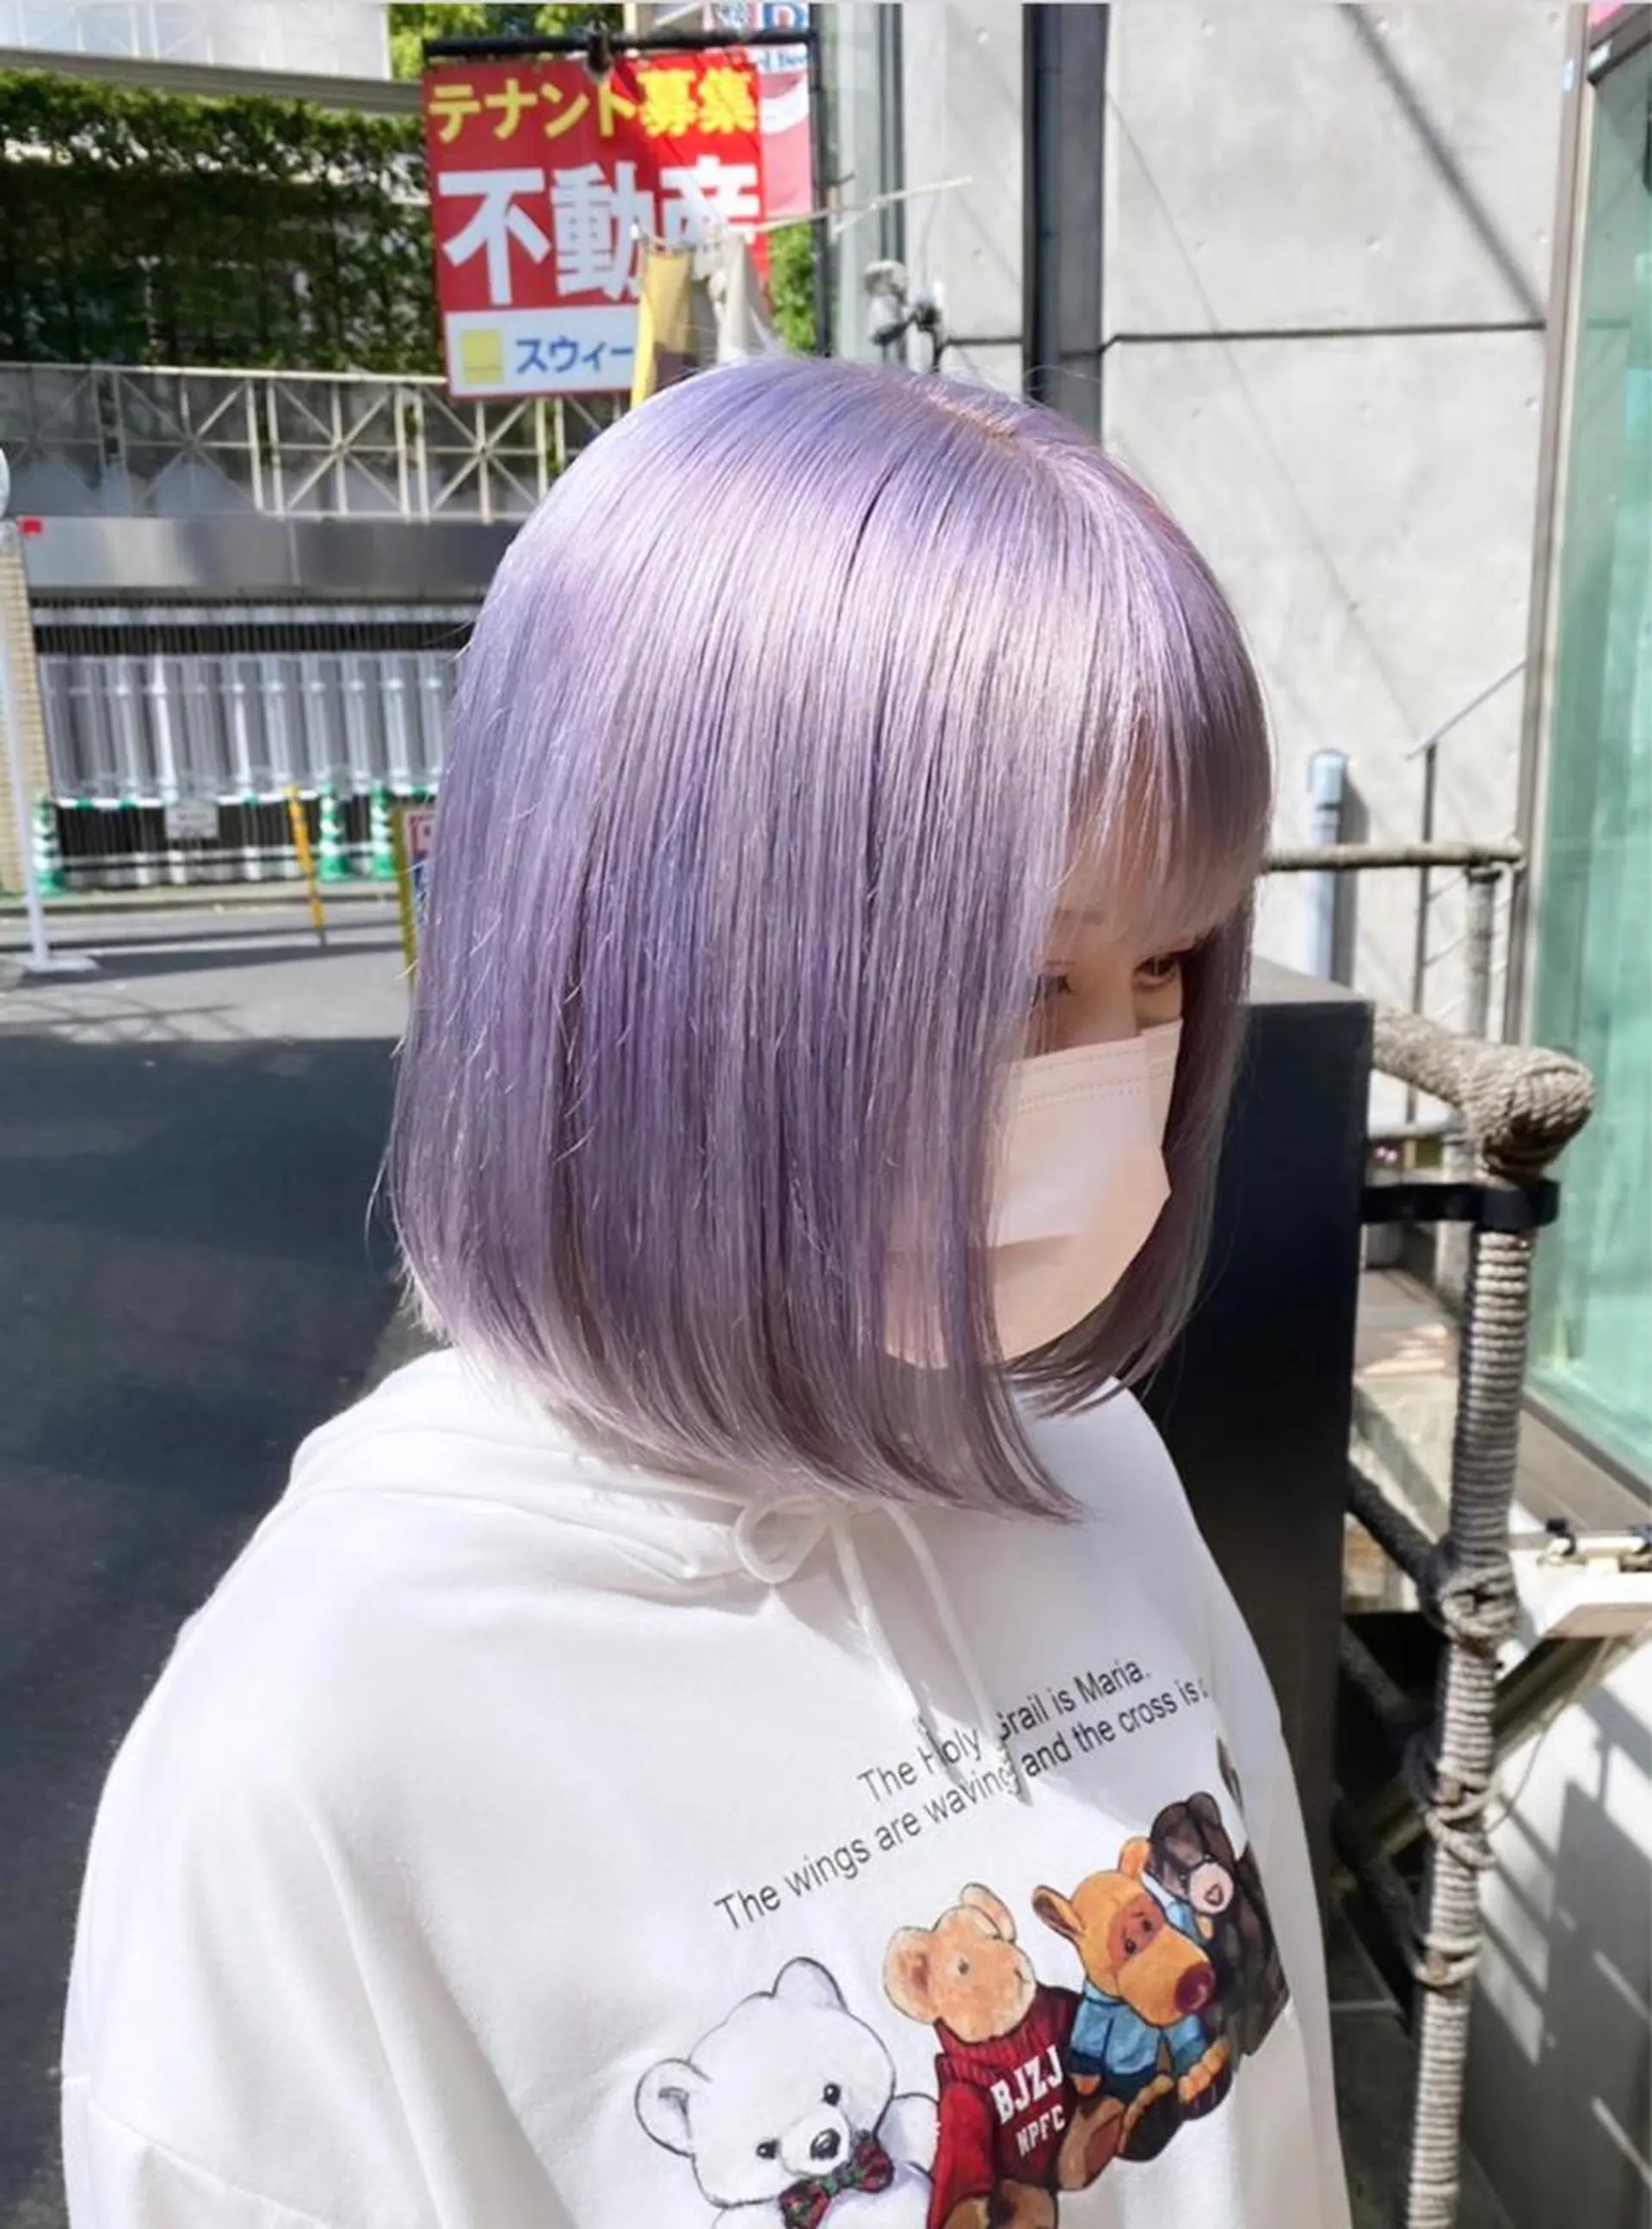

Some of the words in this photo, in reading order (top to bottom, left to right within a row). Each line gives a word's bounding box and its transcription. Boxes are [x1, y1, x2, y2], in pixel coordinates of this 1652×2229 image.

[428, 67, 758, 144] テナント募集
[857, 1760, 917, 1802] The
[917, 1727, 982, 1775] Holy
[1046, 1687, 1076, 1714] is
[1073, 1659, 1151, 1704] Maria.
[713, 1884, 780, 1930] The
[784, 1838, 871, 1897] wings
[875, 1812, 921, 1851] are
[1021, 1731, 1071, 1775] and
[1071, 1721, 1116, 1753] the
[1118, 1692, 1178, 1733] cross
[989, 2044, 1063, 2125] BJZJ
